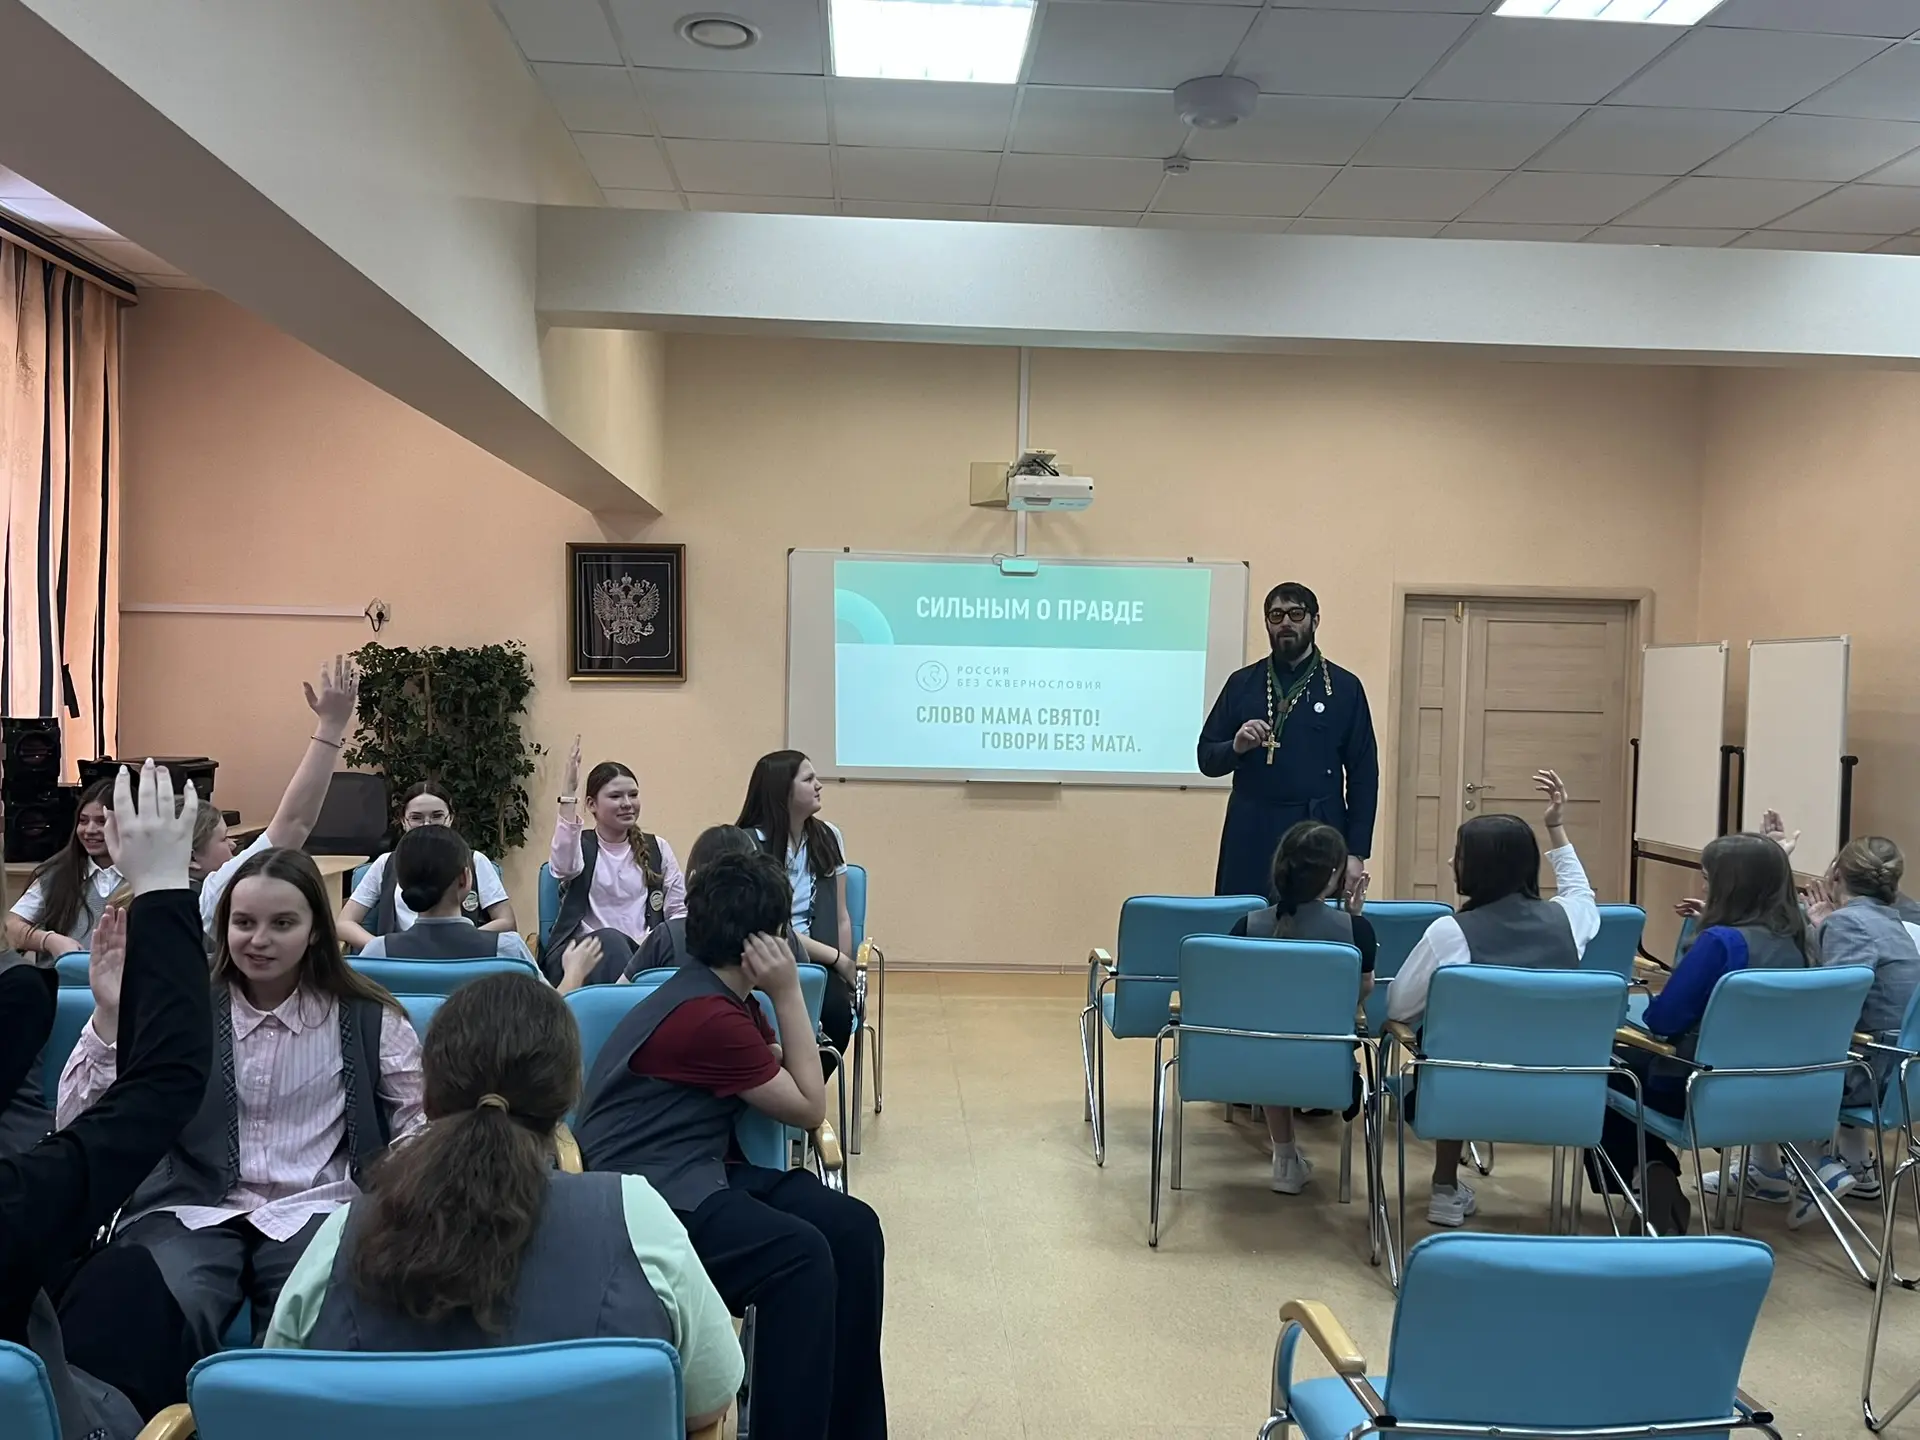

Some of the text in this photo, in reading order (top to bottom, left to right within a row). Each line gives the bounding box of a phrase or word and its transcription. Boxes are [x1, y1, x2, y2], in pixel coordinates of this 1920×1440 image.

[916, 596, 1144, 625] СИЛЬНЫМ О ПРАВДЕ
[957, 665, 1010, 676] РОССИЯ
[957, 678, 1101, 690] БЕЗ СКВЕРНОСЛОВИЯ
[916, 705, 1100, 727] СЛОВО МАМА СВЯТО!
[981, 731, 1142, 753] ГОВОРИ БЕЗ МАТА.
